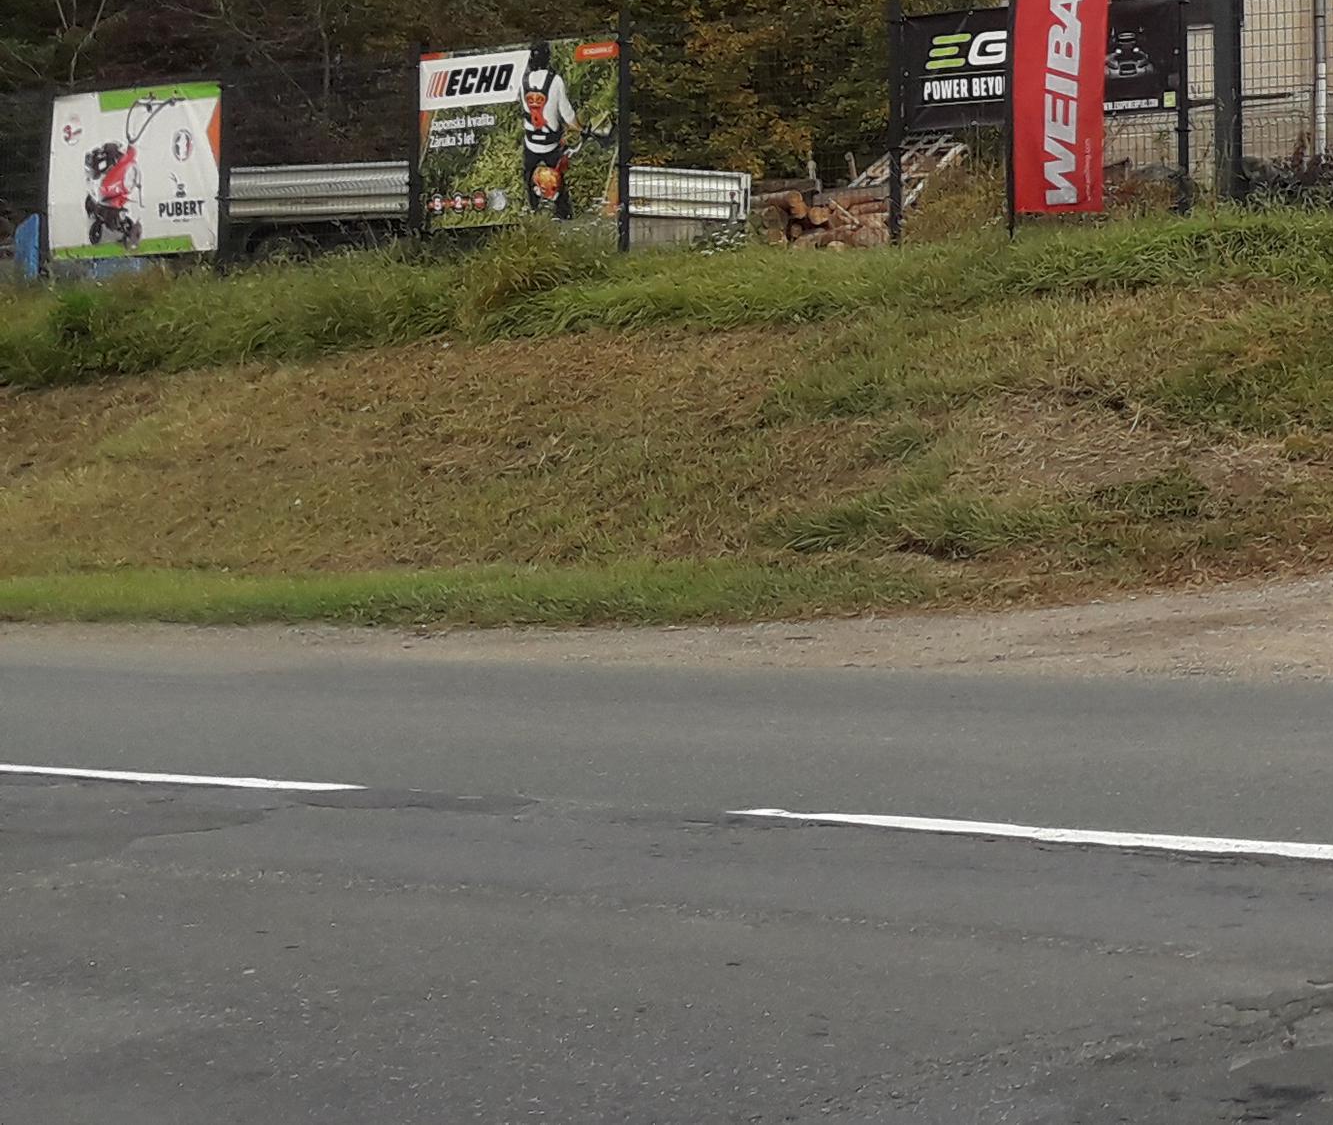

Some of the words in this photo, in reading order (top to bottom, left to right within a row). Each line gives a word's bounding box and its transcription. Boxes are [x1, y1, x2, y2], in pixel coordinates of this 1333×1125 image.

[925, 30, 1008, 70] EG
[445, 63, 514, 97] ECHO
[923, 78, 969, 101] POWER
[972, 75, 1006, 97] BEYO
[430, 134, 456, 148] Záruka
[158, 200, 205, 217] PUBERT
